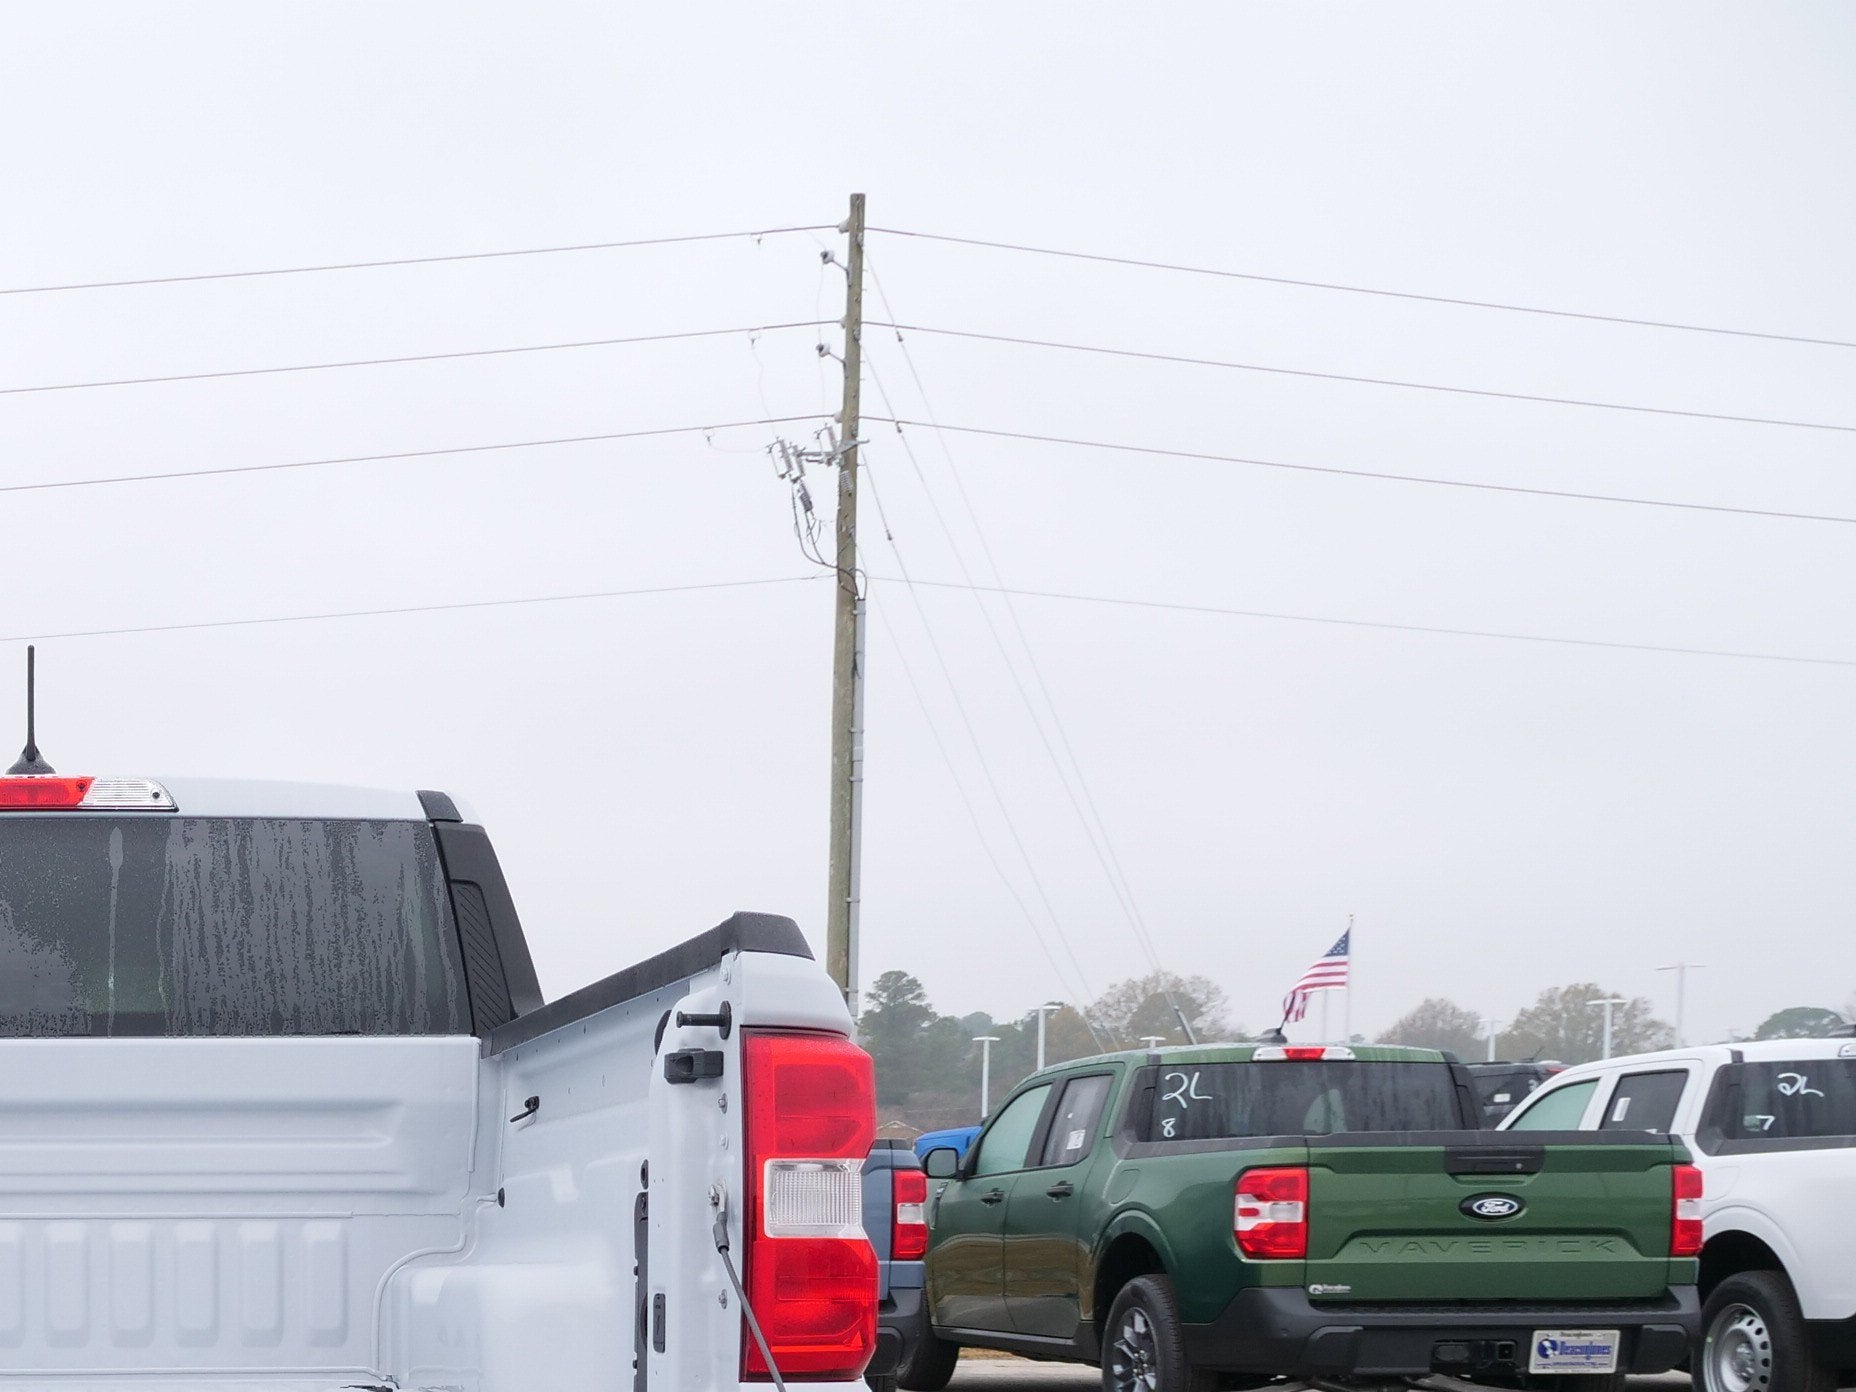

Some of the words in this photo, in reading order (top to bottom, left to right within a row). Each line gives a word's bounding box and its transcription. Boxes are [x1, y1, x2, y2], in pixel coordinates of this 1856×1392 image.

[1161, 1118, 1176, 1137] 8
[1480, 1200, 1512, 1213] Ford
[1358, 1240, 1616, 1254] MAVERICK
